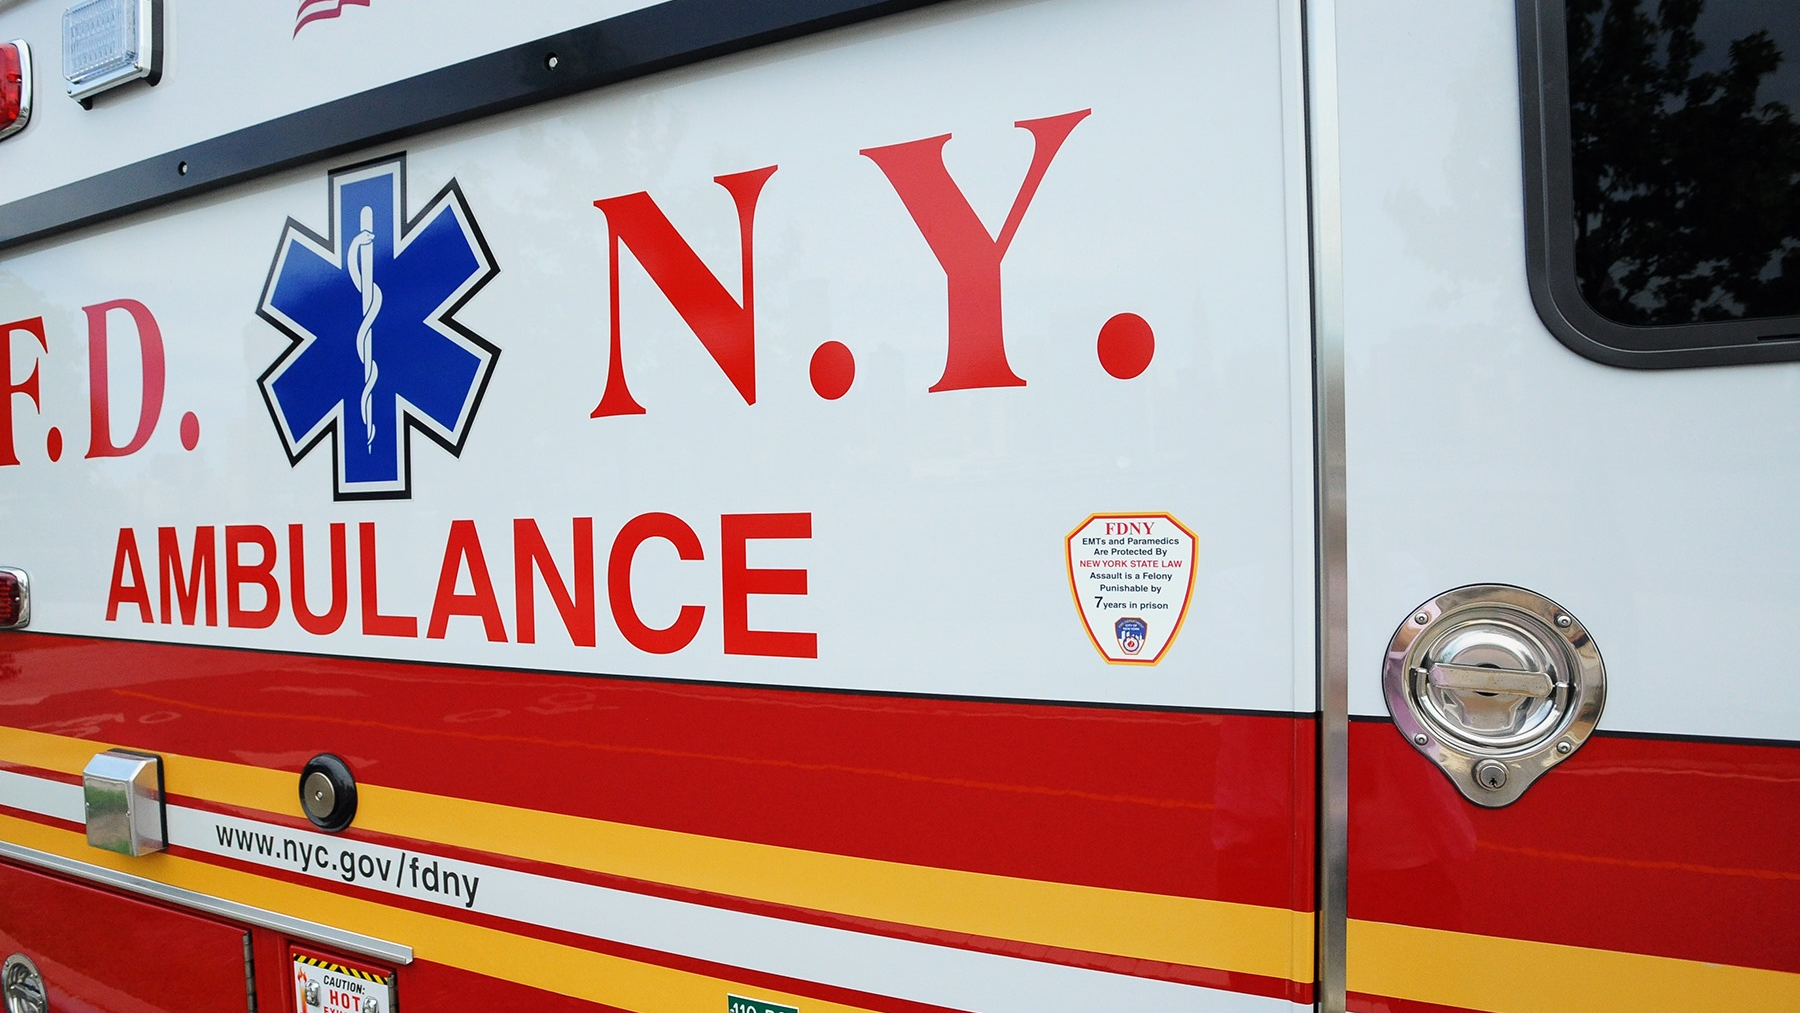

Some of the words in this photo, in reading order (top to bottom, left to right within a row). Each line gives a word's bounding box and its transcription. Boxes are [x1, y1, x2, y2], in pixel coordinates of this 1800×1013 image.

[590, 109, 1156, 419] N.Y.
[1105, 521, 1155, 536] FDNY
[1082, 537, 1106, 546] EMTs
[1108, 537, 1125, 546] and
[1127, 537, 1180, 546] Paramedics
[1093, 548, 1109, 556] Are
[1111, 548, 1153, 556] Protected
[1155, 548, 1168, 557] By
[1079, 560, 1101, 568] NEW
[1102, 560, 1128, 568] YORK
[1130, 560, 1159, 568] STATE
[1161, 560, 1183, 568] LAW
[1089, 572, 1123, 580] Assault
[1124, 572, 1133, 580] is
[1142, 572, 1173, 581] Felony
[105, 511, 819, 659] AMBULANCE
[1099, 584, 1149, 593] Punishable
[1150, 585, 1162, 594] by
[1094, 596, 1104, 609] 7
[1103, 601, 1127, 610] years
[1129, 601, 1138, 609] in
[1139, 601, 1169, 611] prison
[215, 824, 479, 908] www.nyc.gov/fdny
[323, 974, 366, 995] CAUTION:
[329, 989, 361, 1012] HOT
